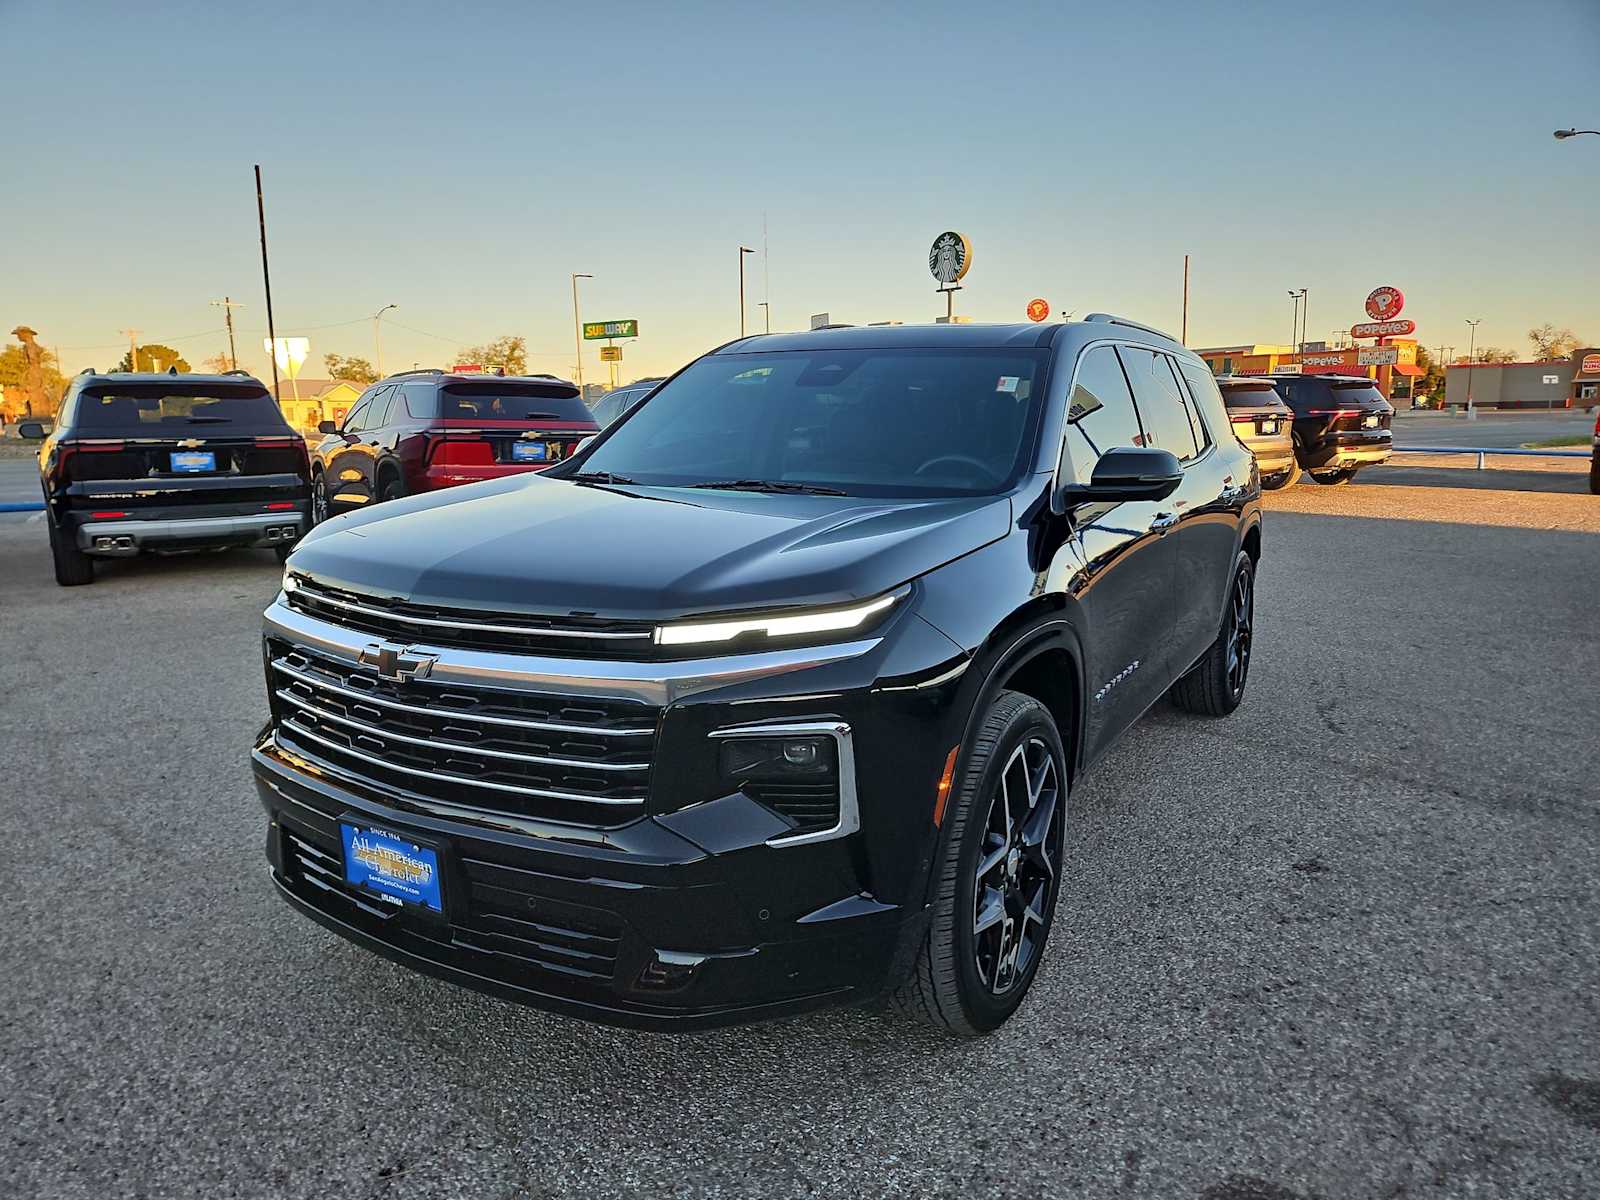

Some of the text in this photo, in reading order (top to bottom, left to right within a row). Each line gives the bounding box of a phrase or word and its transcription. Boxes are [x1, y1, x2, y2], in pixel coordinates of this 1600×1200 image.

[586, 323, 629, 336] SUBWAY
[370, 827, 388, 838] SINCE
[352, 835, 433, 874] All American
